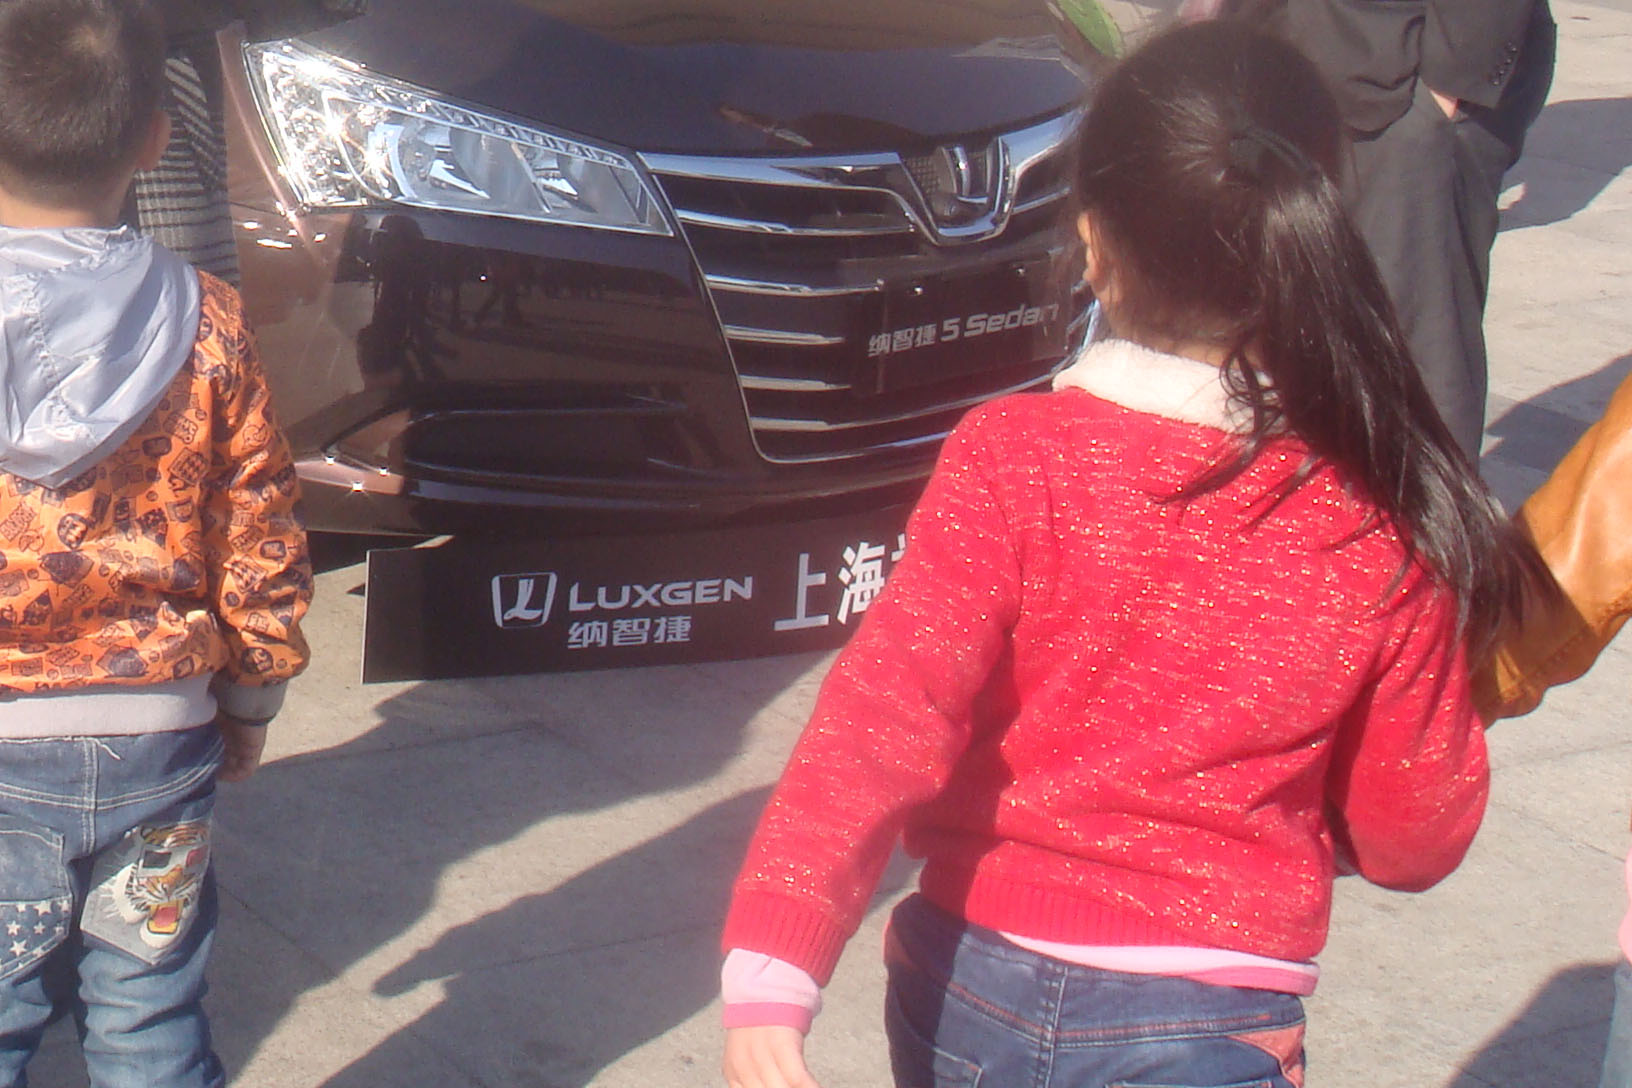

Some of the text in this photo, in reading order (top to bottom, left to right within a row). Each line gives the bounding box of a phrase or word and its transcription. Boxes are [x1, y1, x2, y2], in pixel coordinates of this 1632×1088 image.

[868, 303, 1060, 357] 纳智捷 5 Sedan
[568, 576, 753, 612] LUXGEN
[774, 533, 906, 631] 上海
[567, 616, 693, 649] 纳智捷
